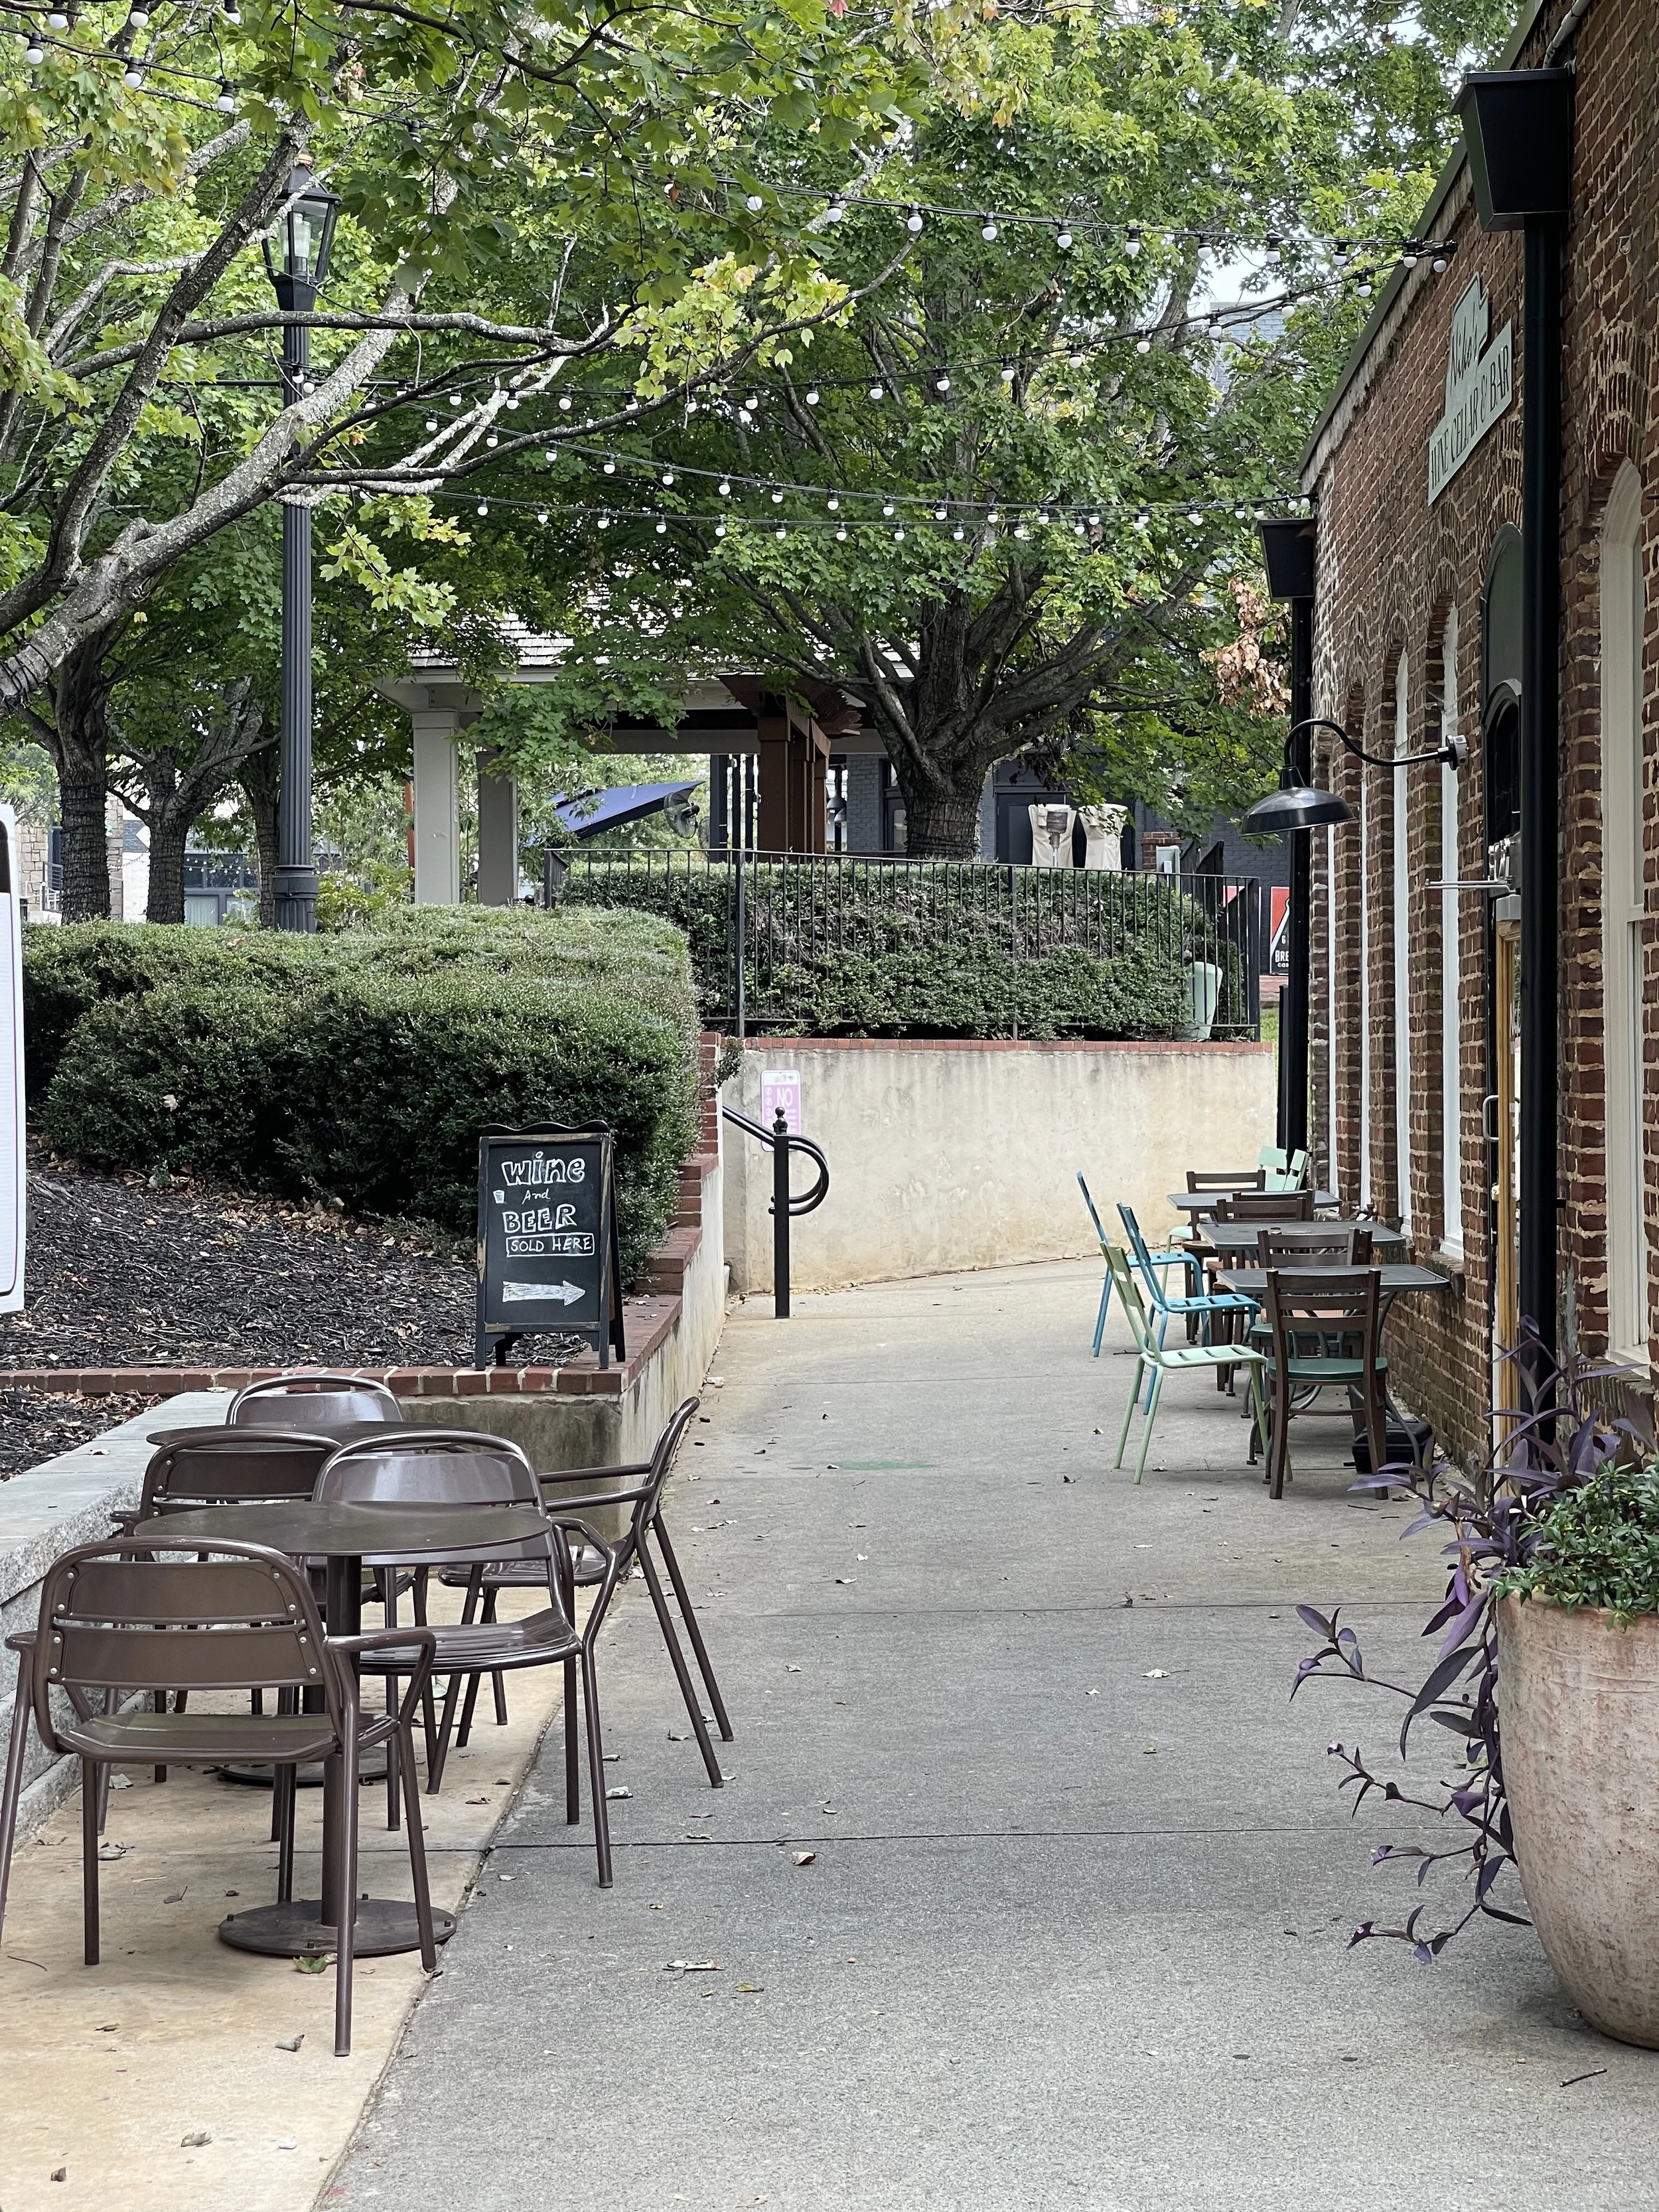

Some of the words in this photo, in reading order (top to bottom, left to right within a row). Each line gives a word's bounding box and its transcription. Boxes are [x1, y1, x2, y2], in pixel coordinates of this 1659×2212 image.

[1431, 428, 1449, 490] WINE
[1451, 387, 1478, 463] CELLAR
[1480, 375, 1488, 423] &
[1490, 345, 1510, 413] BAR
[776, 1087, 793, 1107] NO
[522, 1188, 551, 1205] And
[502, 1203, 577, 1234] BEER
[510, 1239, 545, 1252] SOLD
[552, 1236, 593, 1252] HERE
